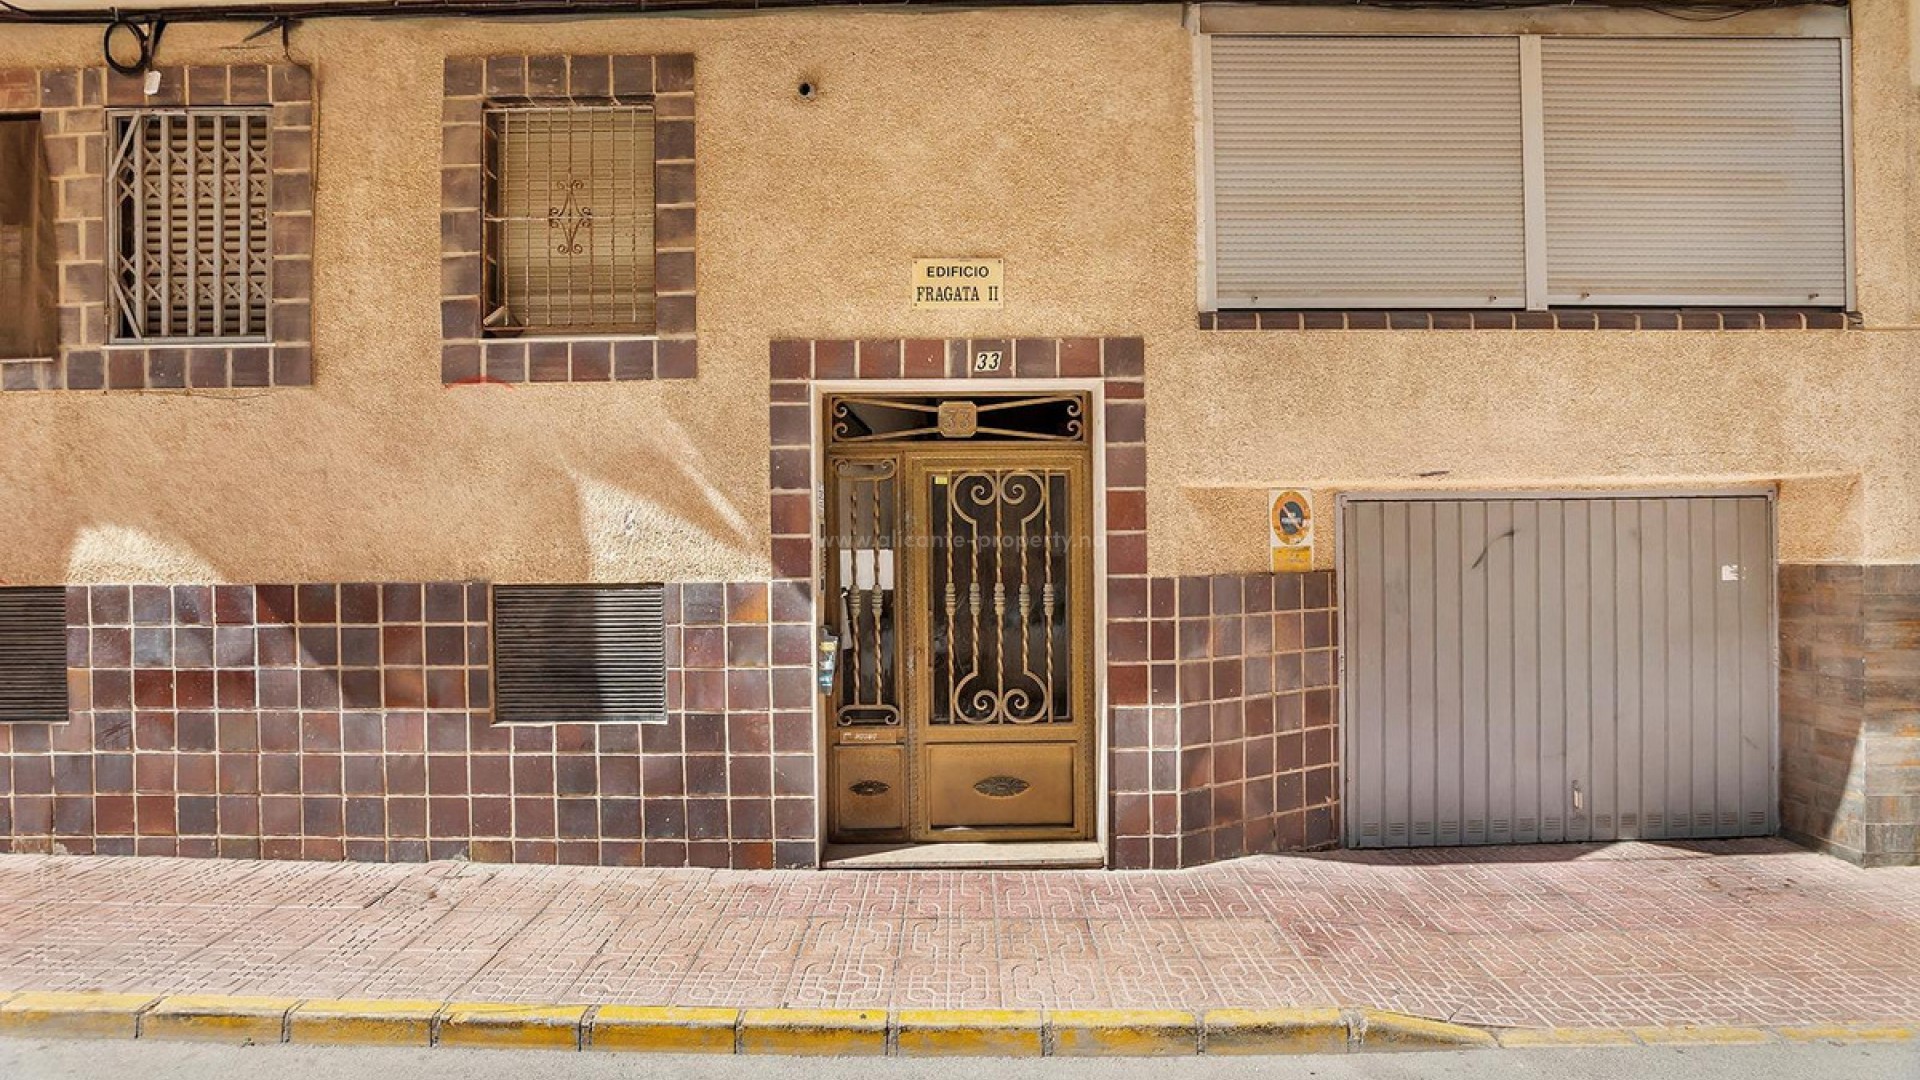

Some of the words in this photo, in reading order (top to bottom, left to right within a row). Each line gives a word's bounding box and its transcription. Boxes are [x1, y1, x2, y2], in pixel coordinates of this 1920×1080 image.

[926, 265, 989, 278] EDIFICIO
[916, 286, 980, 301] FRAGATA
[988, 286, 999, 301] II
[977, 352, 999, 370] 33
